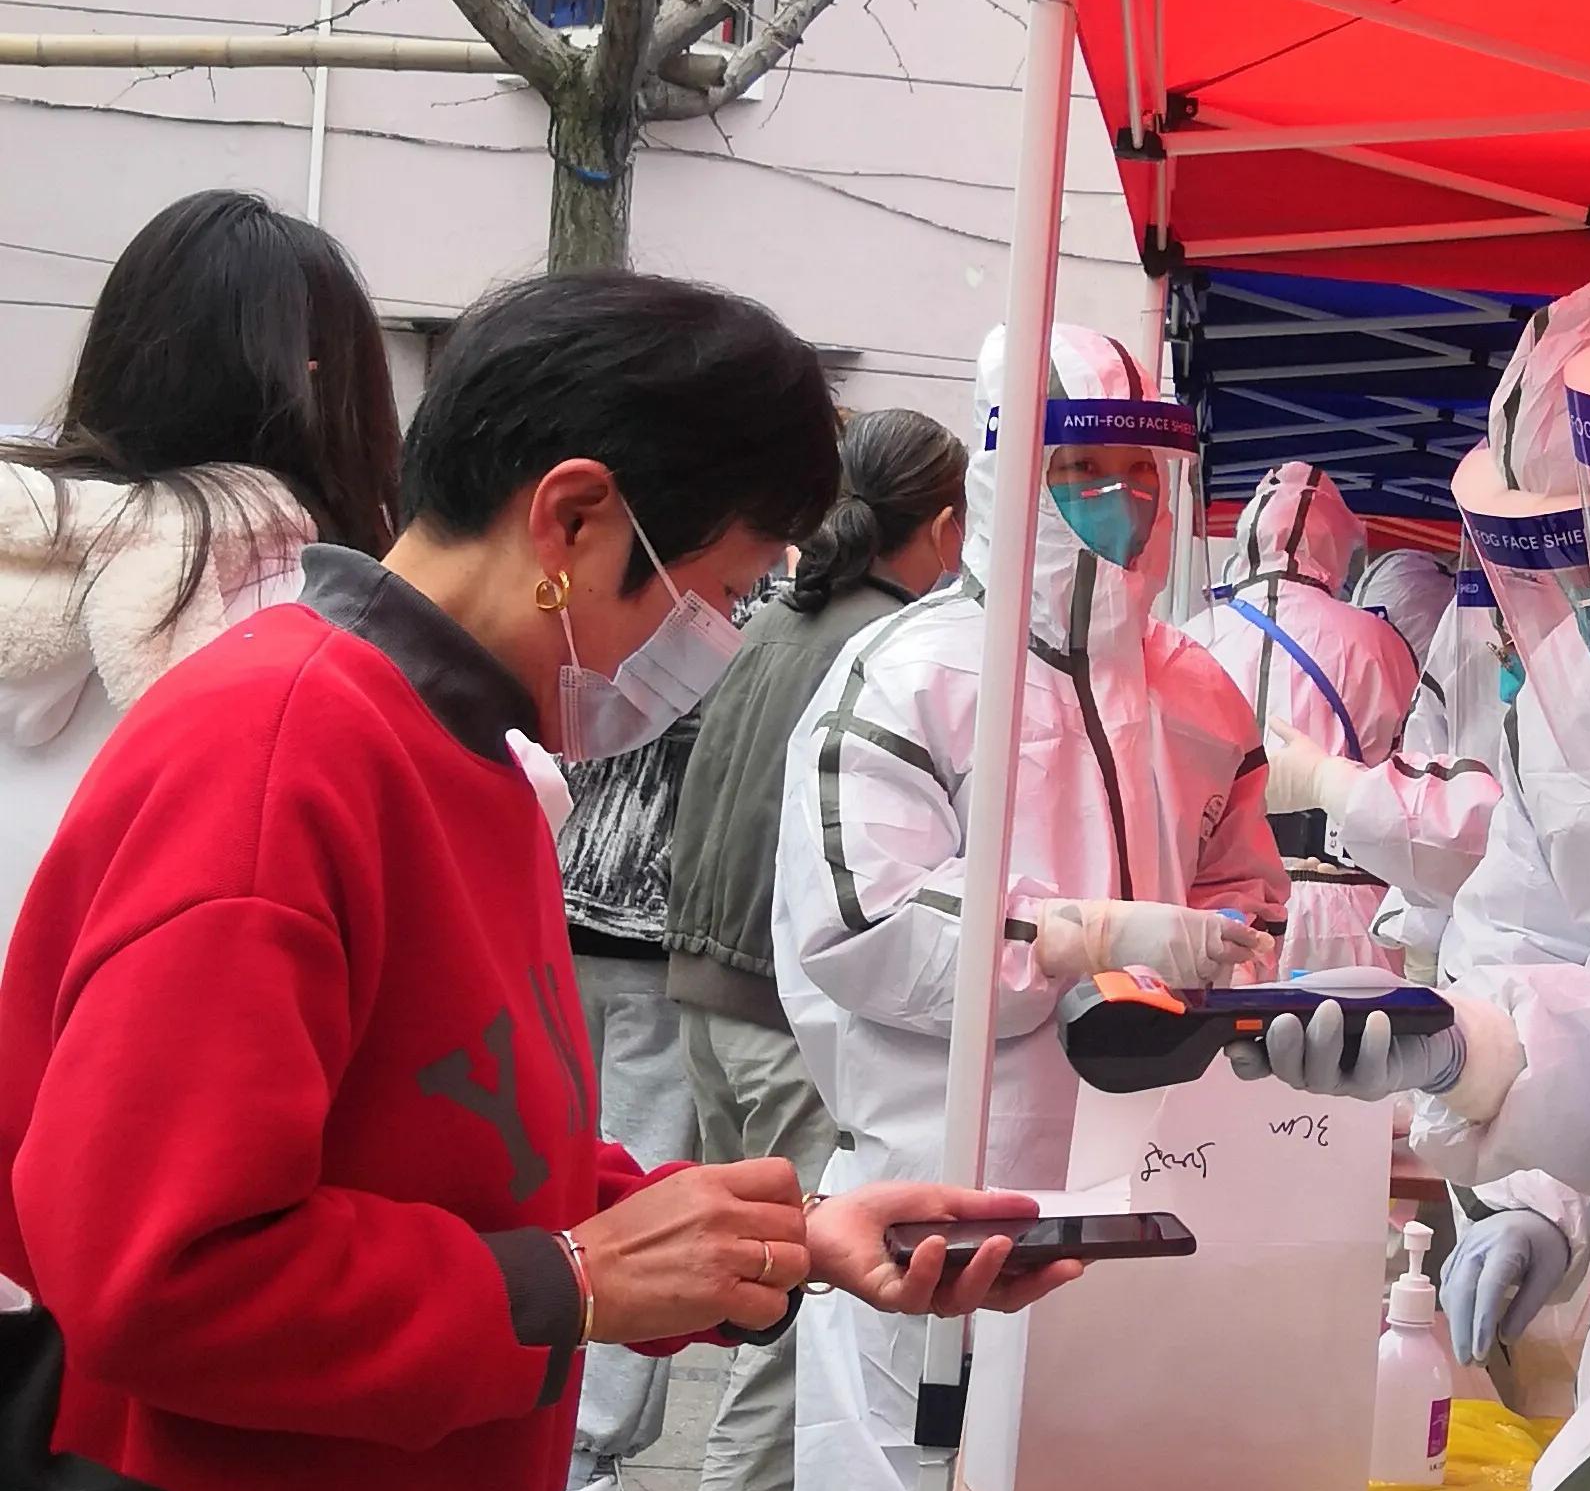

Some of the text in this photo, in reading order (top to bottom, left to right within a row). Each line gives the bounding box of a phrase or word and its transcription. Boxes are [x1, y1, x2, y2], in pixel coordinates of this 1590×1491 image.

[1064, 414, 1135, 429] ANTI-FOG
[1139, 416, 1169, 431] FACE
[1502, 536, 1540, 550] FACE
